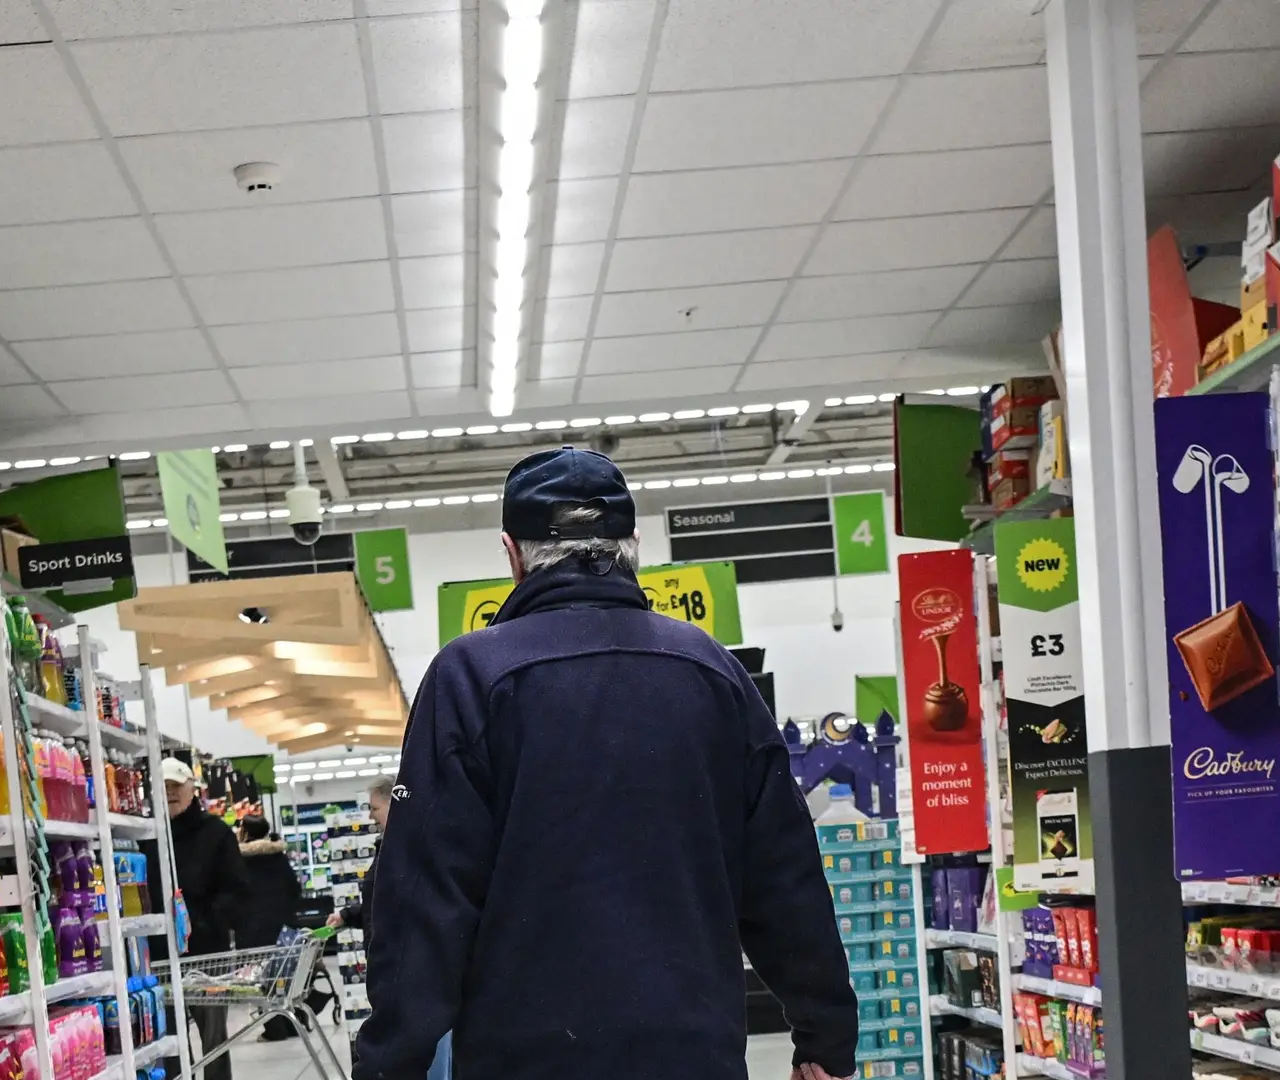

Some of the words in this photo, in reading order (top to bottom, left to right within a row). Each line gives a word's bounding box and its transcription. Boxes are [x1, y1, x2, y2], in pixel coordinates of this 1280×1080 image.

[673, 510, 735, 531] Seasonal
[851, 519, 876, 548] 4
[28, 553, 75, 574] Sport
[80, 549, 124, 570] Drinks
[374, 556, 396, 585] 5
[664, 577, 680, 589] any
[656, 600, 669, 613] for
[671, 590, 707, 622] £18
[1030, 633, 1065, 658] £3
[923, 762, 957, 776] Enjoy
[960, 764, 968, 772] a
[1015, 760, 1046, 770] Discover
[1046, 757, 1087, 769] EXCELLENC
[1183, 747, 1275, 779] Cadbury
[922, 778, 972, 791] moment
[926, 794, 941, 808] of
[942, 794, 970, 807] bliss
